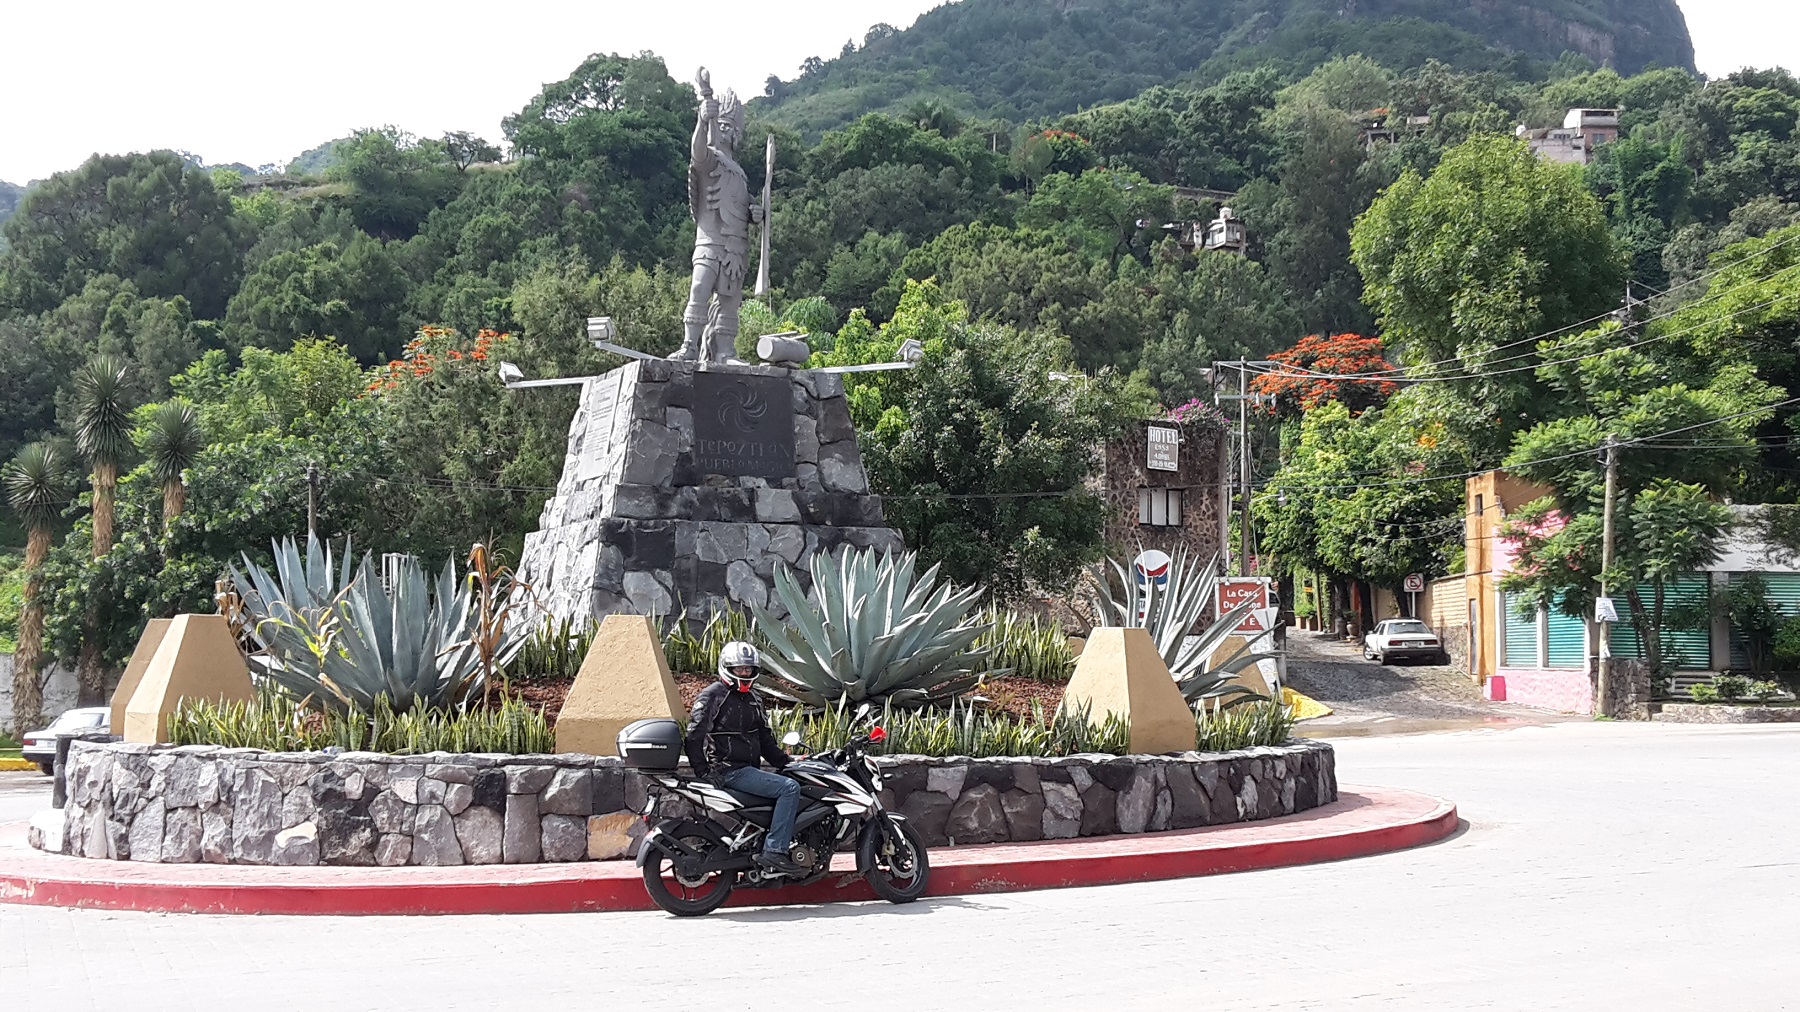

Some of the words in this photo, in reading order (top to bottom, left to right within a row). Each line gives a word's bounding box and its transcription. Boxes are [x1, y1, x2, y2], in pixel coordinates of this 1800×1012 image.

[1150, 429, 1177, 445] HOTEL
[1227, 589, 1236, 598] La
[1223, 601, 1235, 609] De
